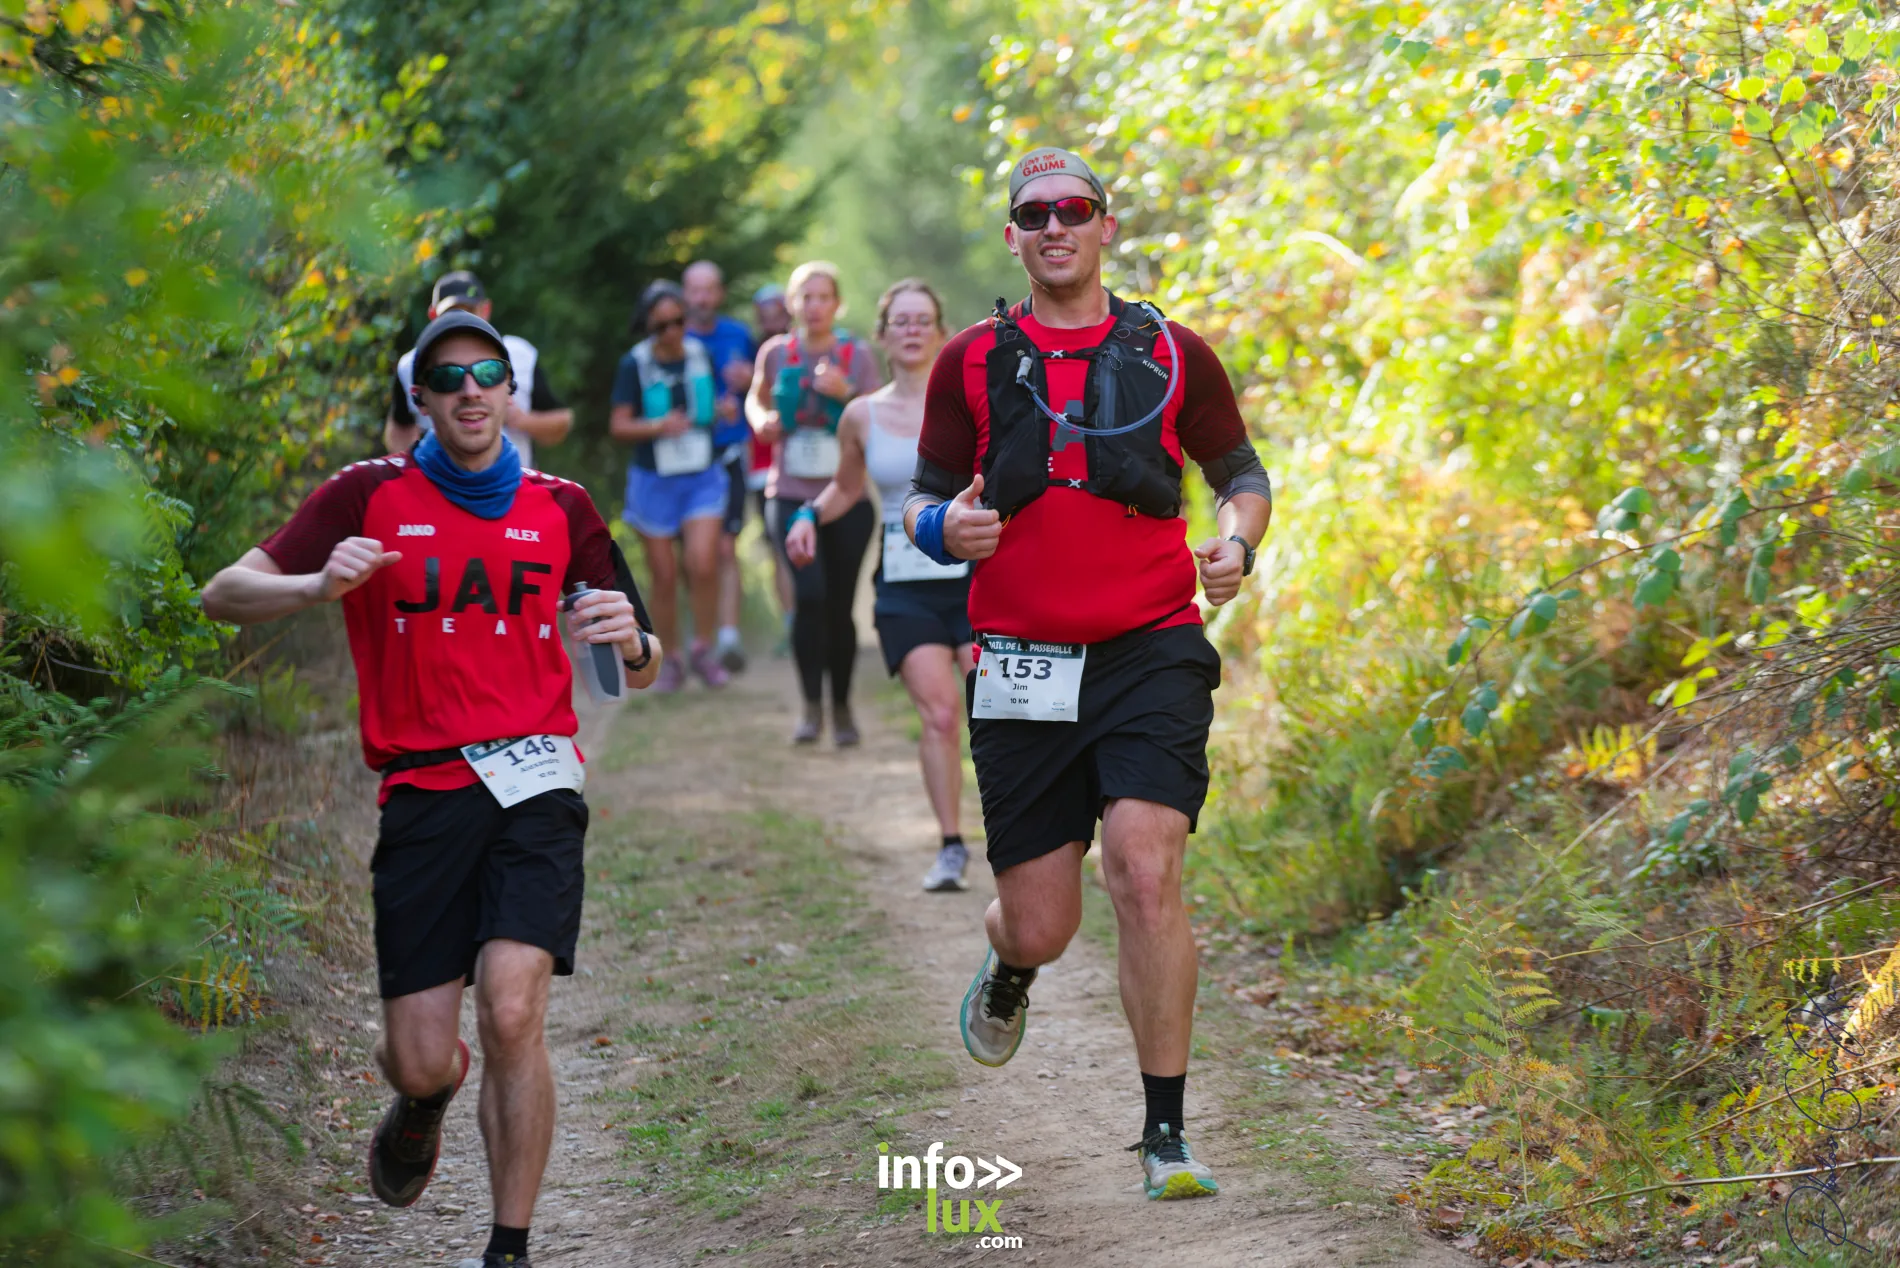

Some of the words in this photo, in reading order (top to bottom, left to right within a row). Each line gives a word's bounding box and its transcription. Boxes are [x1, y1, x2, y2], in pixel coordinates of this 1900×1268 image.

[1022, 159, 1066, 177] GAUME
[1142, 359, 1169, 380] KIPRUN
[396, 524, 436, 537] JAKO
[504, 527, 540, 543] ALEX
[394, 557, 552, 615] JAF
[1006, 642, 1016, 651] DE
[1029, 643, 1073, 654] PASSERELLE
[999, 657, 1053, 680] 153
[1012, 683, 1028, 691] Jim
[503, 734, 557, 766] 146
